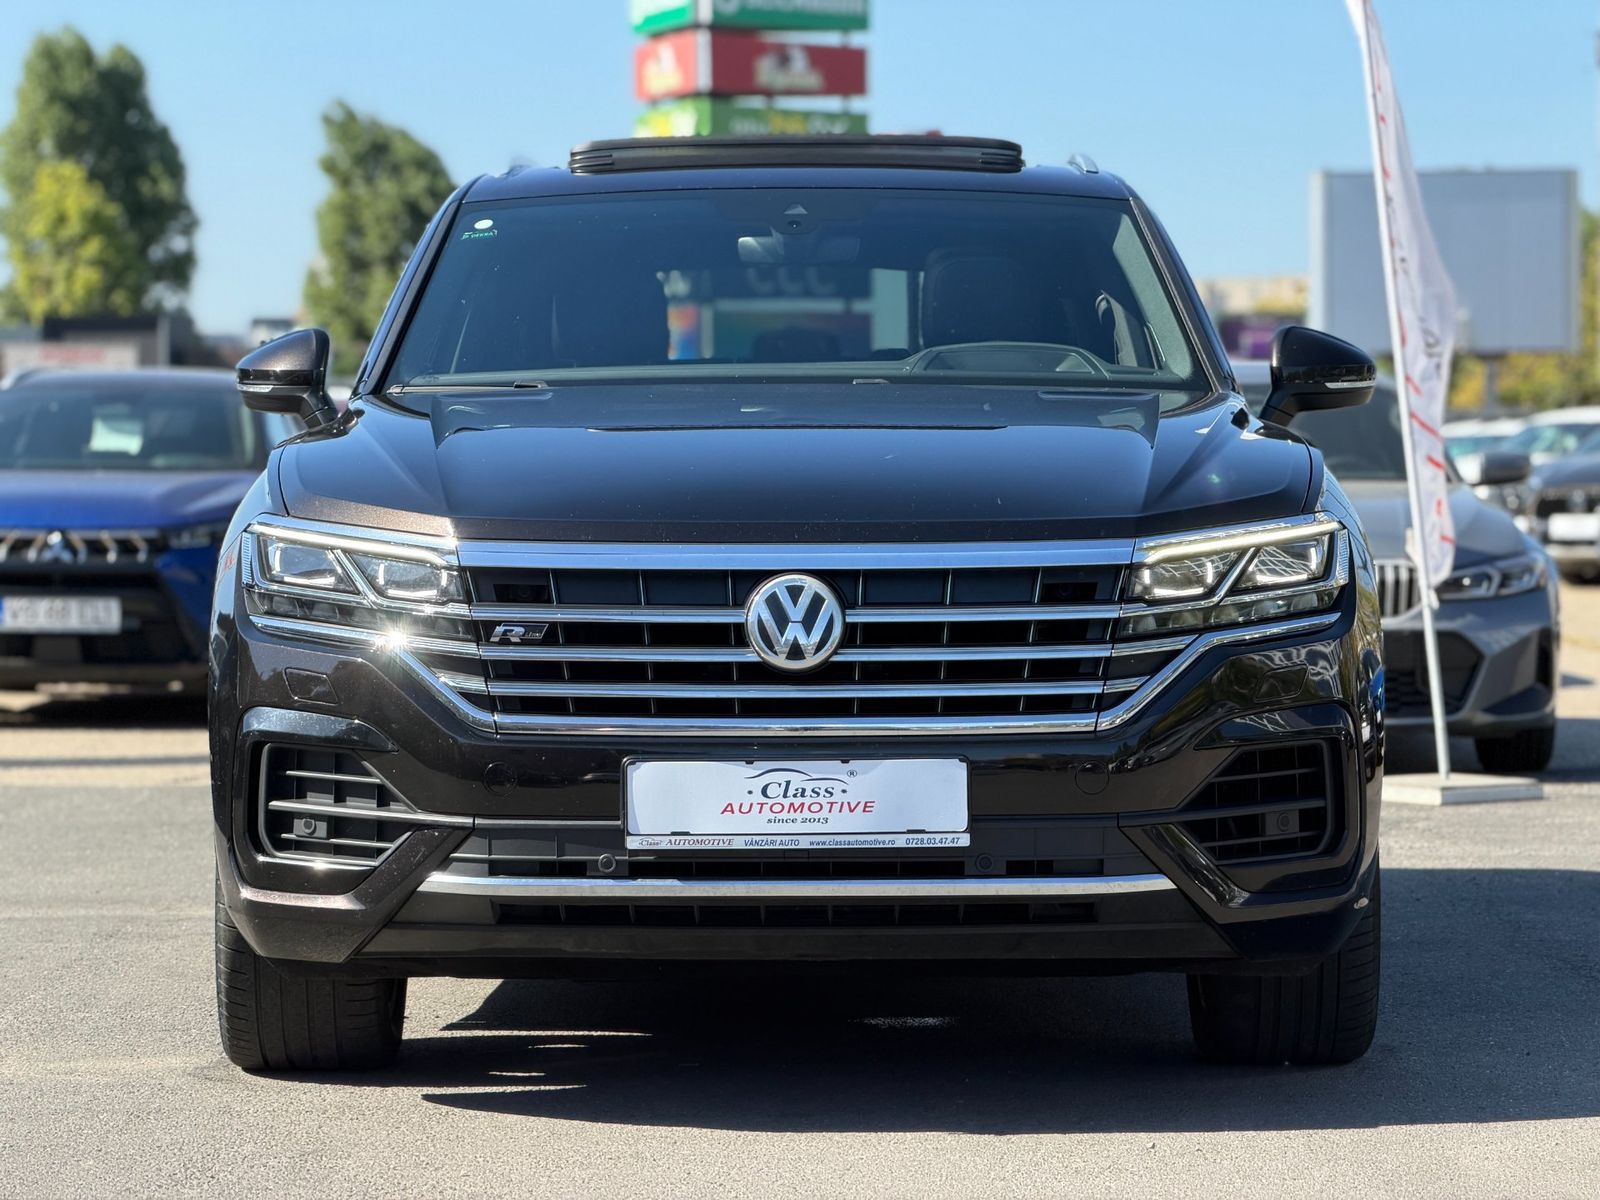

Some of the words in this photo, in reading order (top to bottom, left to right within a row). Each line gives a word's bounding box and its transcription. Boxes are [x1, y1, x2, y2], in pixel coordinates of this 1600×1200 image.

[760, 780, 835, 799] Class
[720, 800, 876, 815] AUTOMOTIVE
[766, 816, 798, 825] since
[800, 816, 829, 825] 2013
[665, 838, 734, 847] AUTOMOTIVE
[778, 839, 800, 847] AUTO
[809, 837, 896, 847] www.classautomotive.ro
[905, 836, 960, 846] 0728.03.47.47
